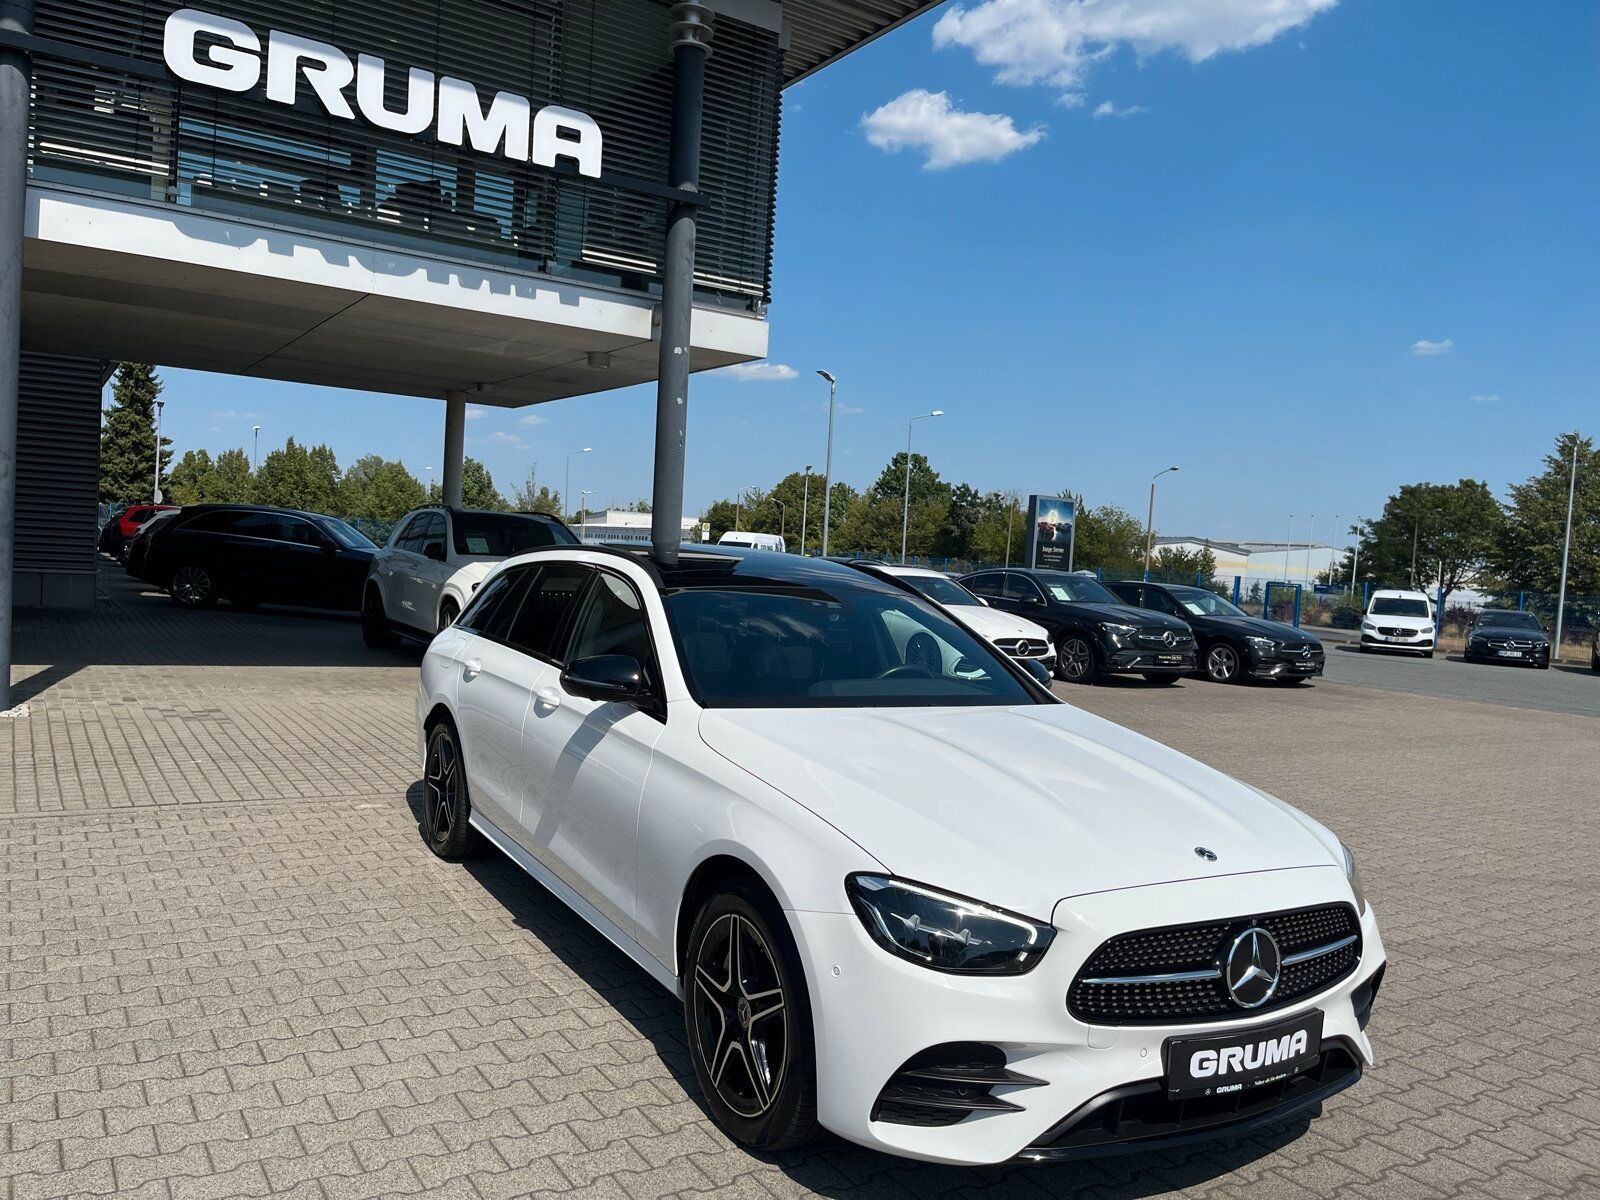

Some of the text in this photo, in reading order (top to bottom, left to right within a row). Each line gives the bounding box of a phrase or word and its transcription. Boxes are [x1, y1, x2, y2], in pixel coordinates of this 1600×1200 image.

[163, 8, 603, 178] GRUMA
[1189, 1029, 1308, 1078] GRUMA
[1216, 1083, 1243, 1094] GRUMA
